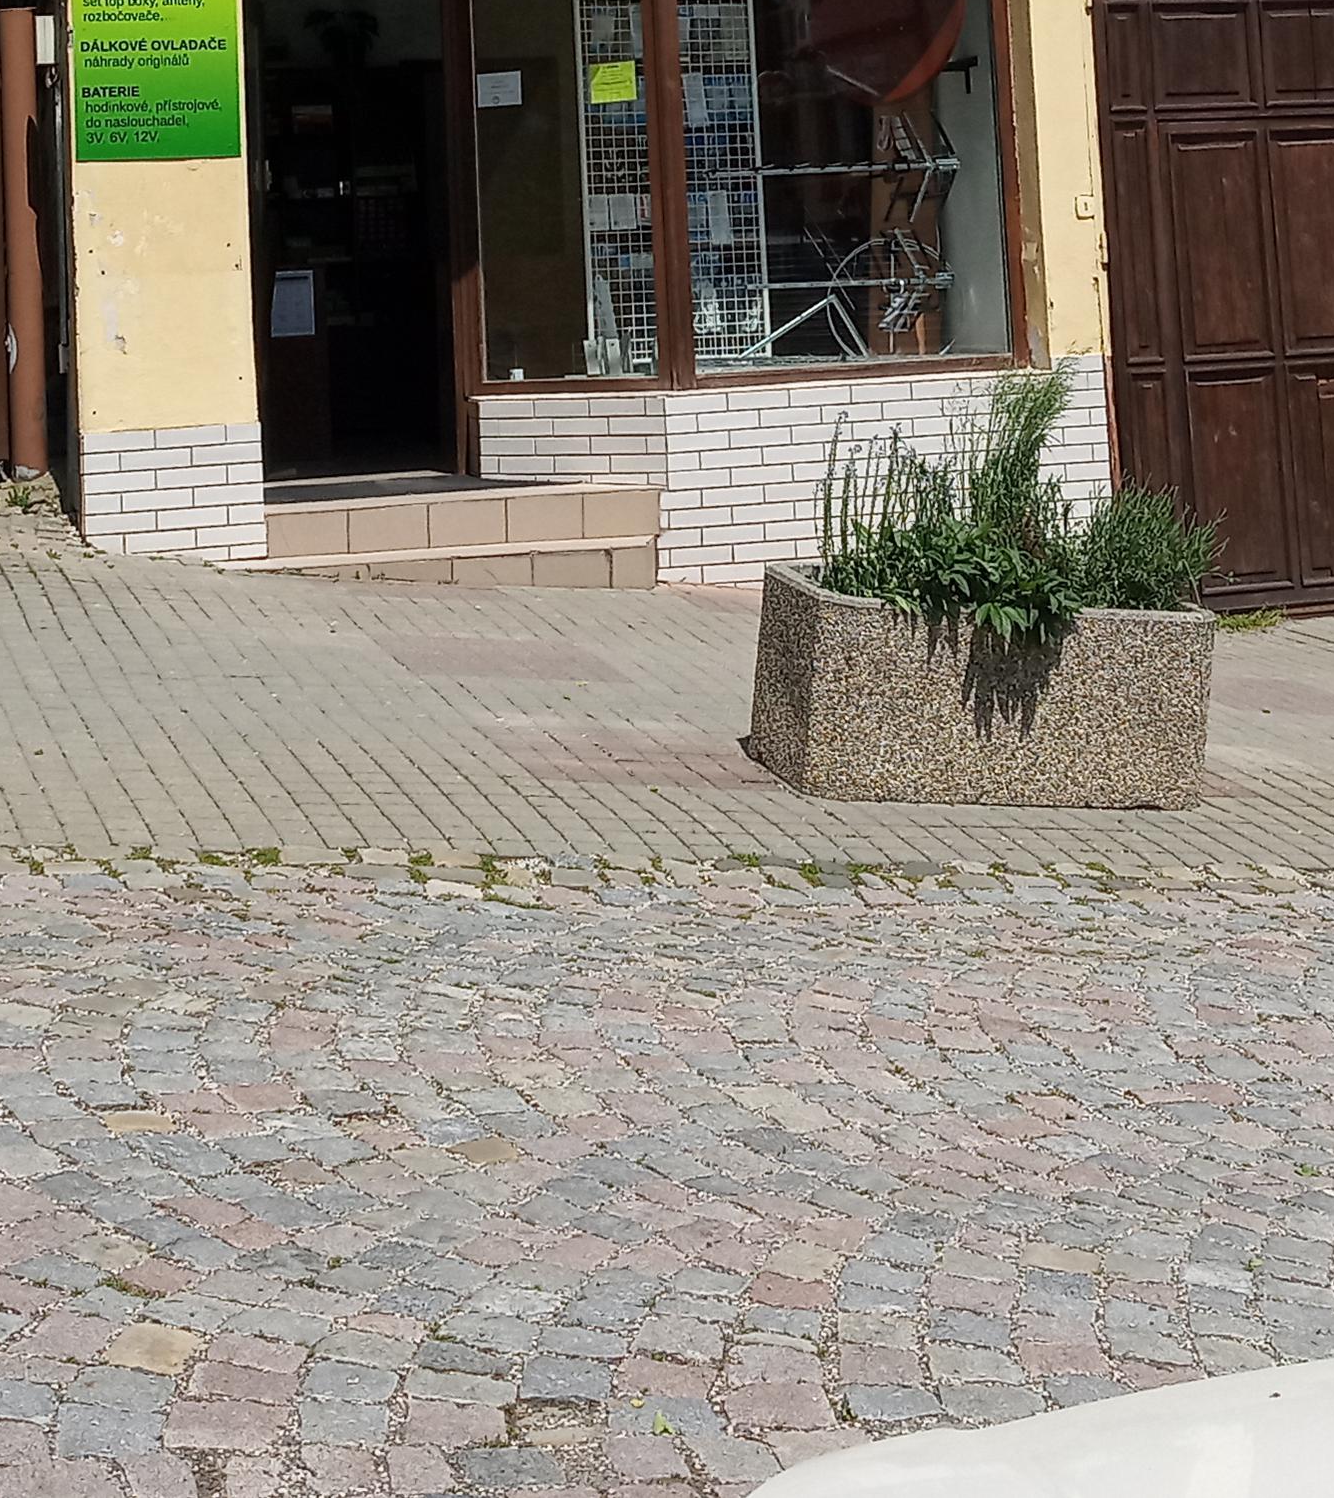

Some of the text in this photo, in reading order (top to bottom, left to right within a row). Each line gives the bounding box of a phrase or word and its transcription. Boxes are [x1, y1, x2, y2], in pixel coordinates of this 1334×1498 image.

[80, 37, 227, 52] DÁLKOVÉ OVLADAČE
[84, 54, 191, 69] náhrady originálů
[81, 86, 140, 98] BATERIE
[85, 101, 153, 113] hodinkové,
[85, 115, 190, 129] do naslouchadel,
